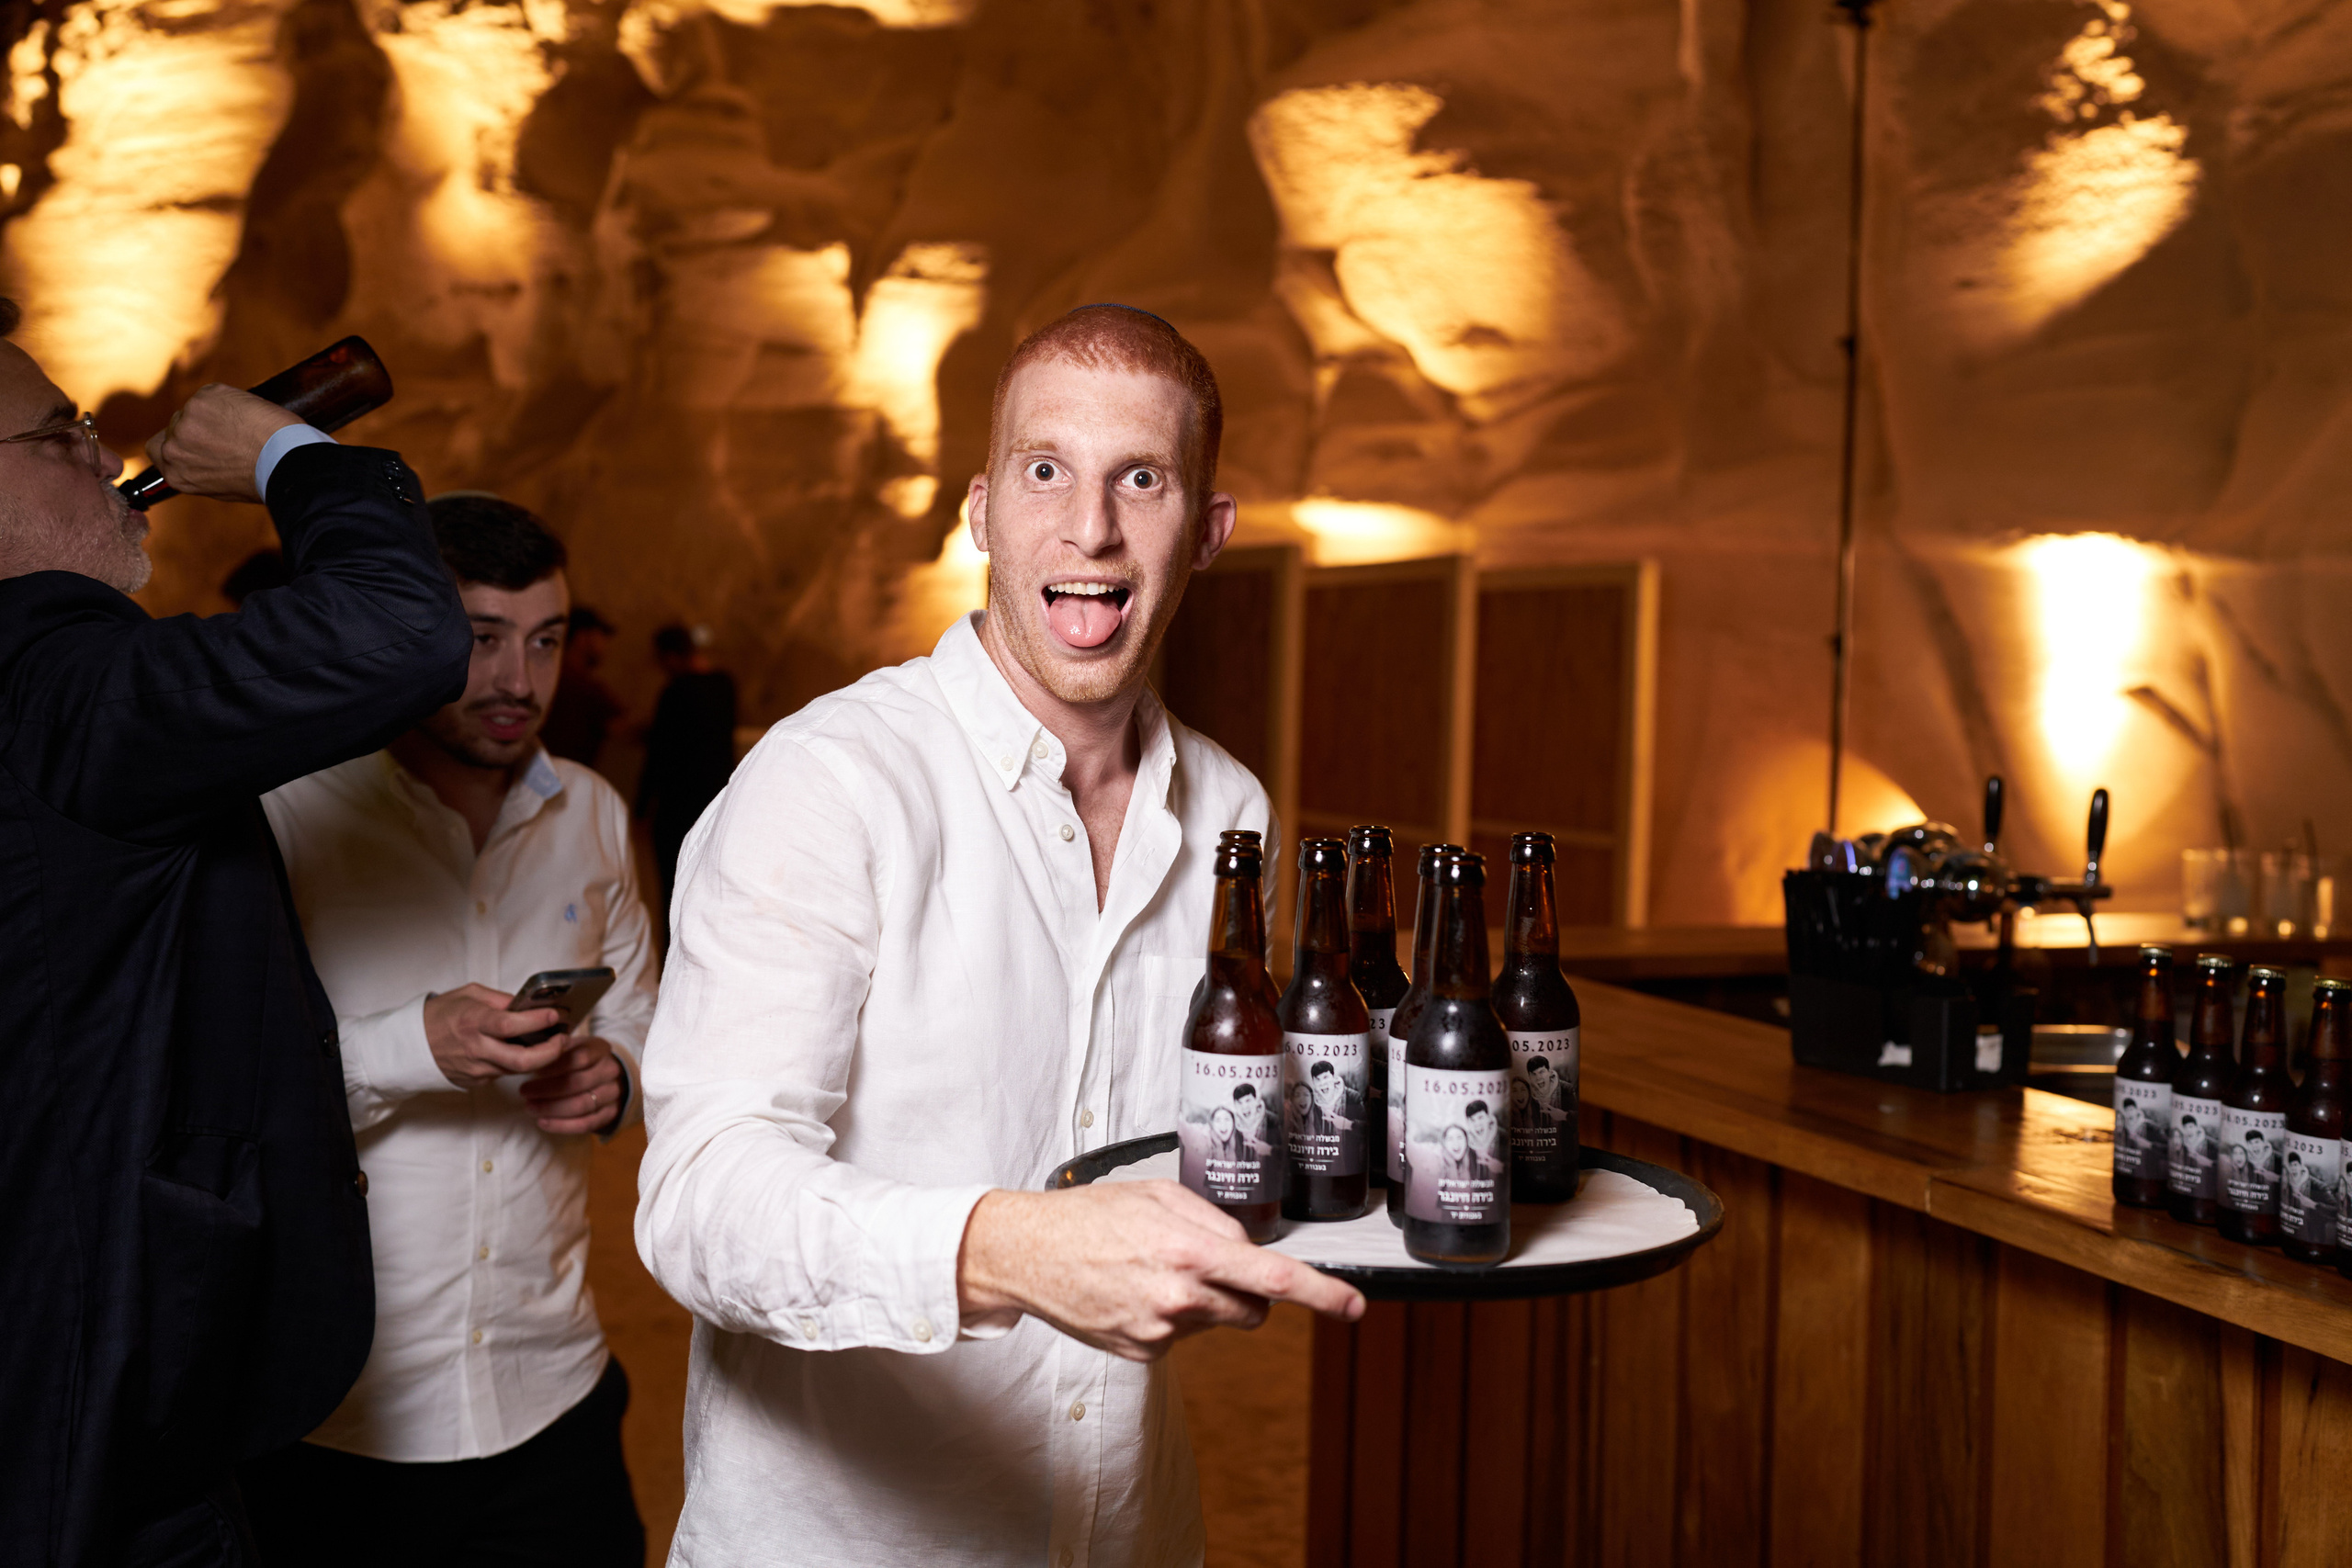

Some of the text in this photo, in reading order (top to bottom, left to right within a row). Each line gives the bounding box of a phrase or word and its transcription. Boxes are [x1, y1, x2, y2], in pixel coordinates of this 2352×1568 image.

[1284, 1041, 1357, 1057] 6.05.2023
[1512, 1039, 1570, 1053] 05.2023
[1196, 1063, 1278, 1078] 16.05.2023
[1424, 1079, 1508, 1096] 16.05.2023
[1510, 1127, 1533, 1135] ישראלי
[1536, 1138, 1557, 1147] בירה
[1317, 1146, 1340, 1156] בירה
[1238, 1173, 1260, 1184] בירה
[1471, 1191, 1494, 1203] בירה
